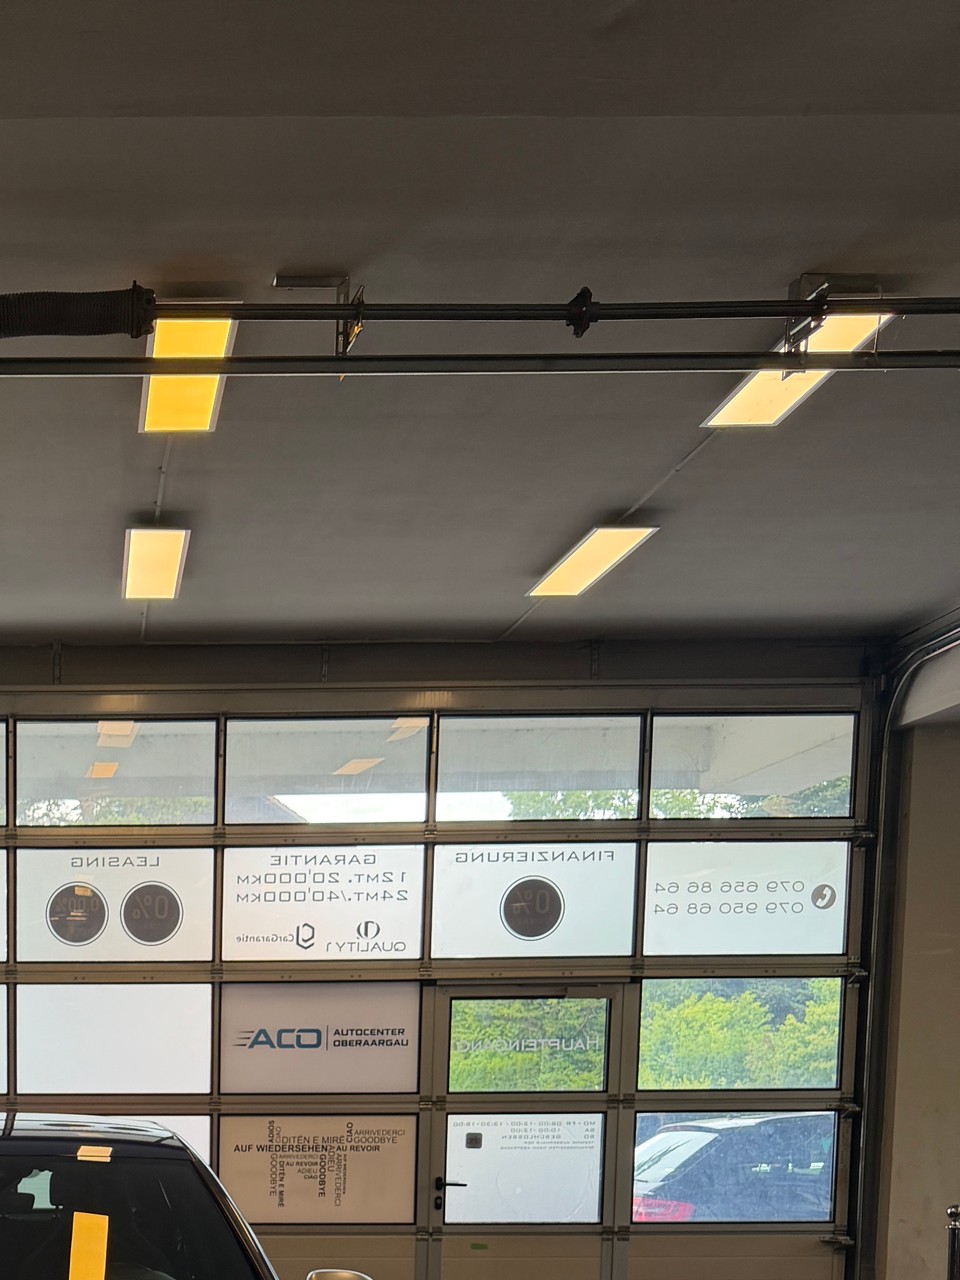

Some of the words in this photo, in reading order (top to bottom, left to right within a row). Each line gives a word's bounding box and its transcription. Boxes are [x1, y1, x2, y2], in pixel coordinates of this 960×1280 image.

[248, 1028, 322, 1049] ACO
[333, 1028, 405, 1037] AUTOCENTER
[333, 1038, 409, 1047] OBERAARGAU
[234, 1144, 253, 1152] AUF
[257, 1144, 328, 1153] WIEDERSEHEN
[270, 1153, 278, 1196] GOODBYE
[318, 1153, 327, 1197] GOODBYE
